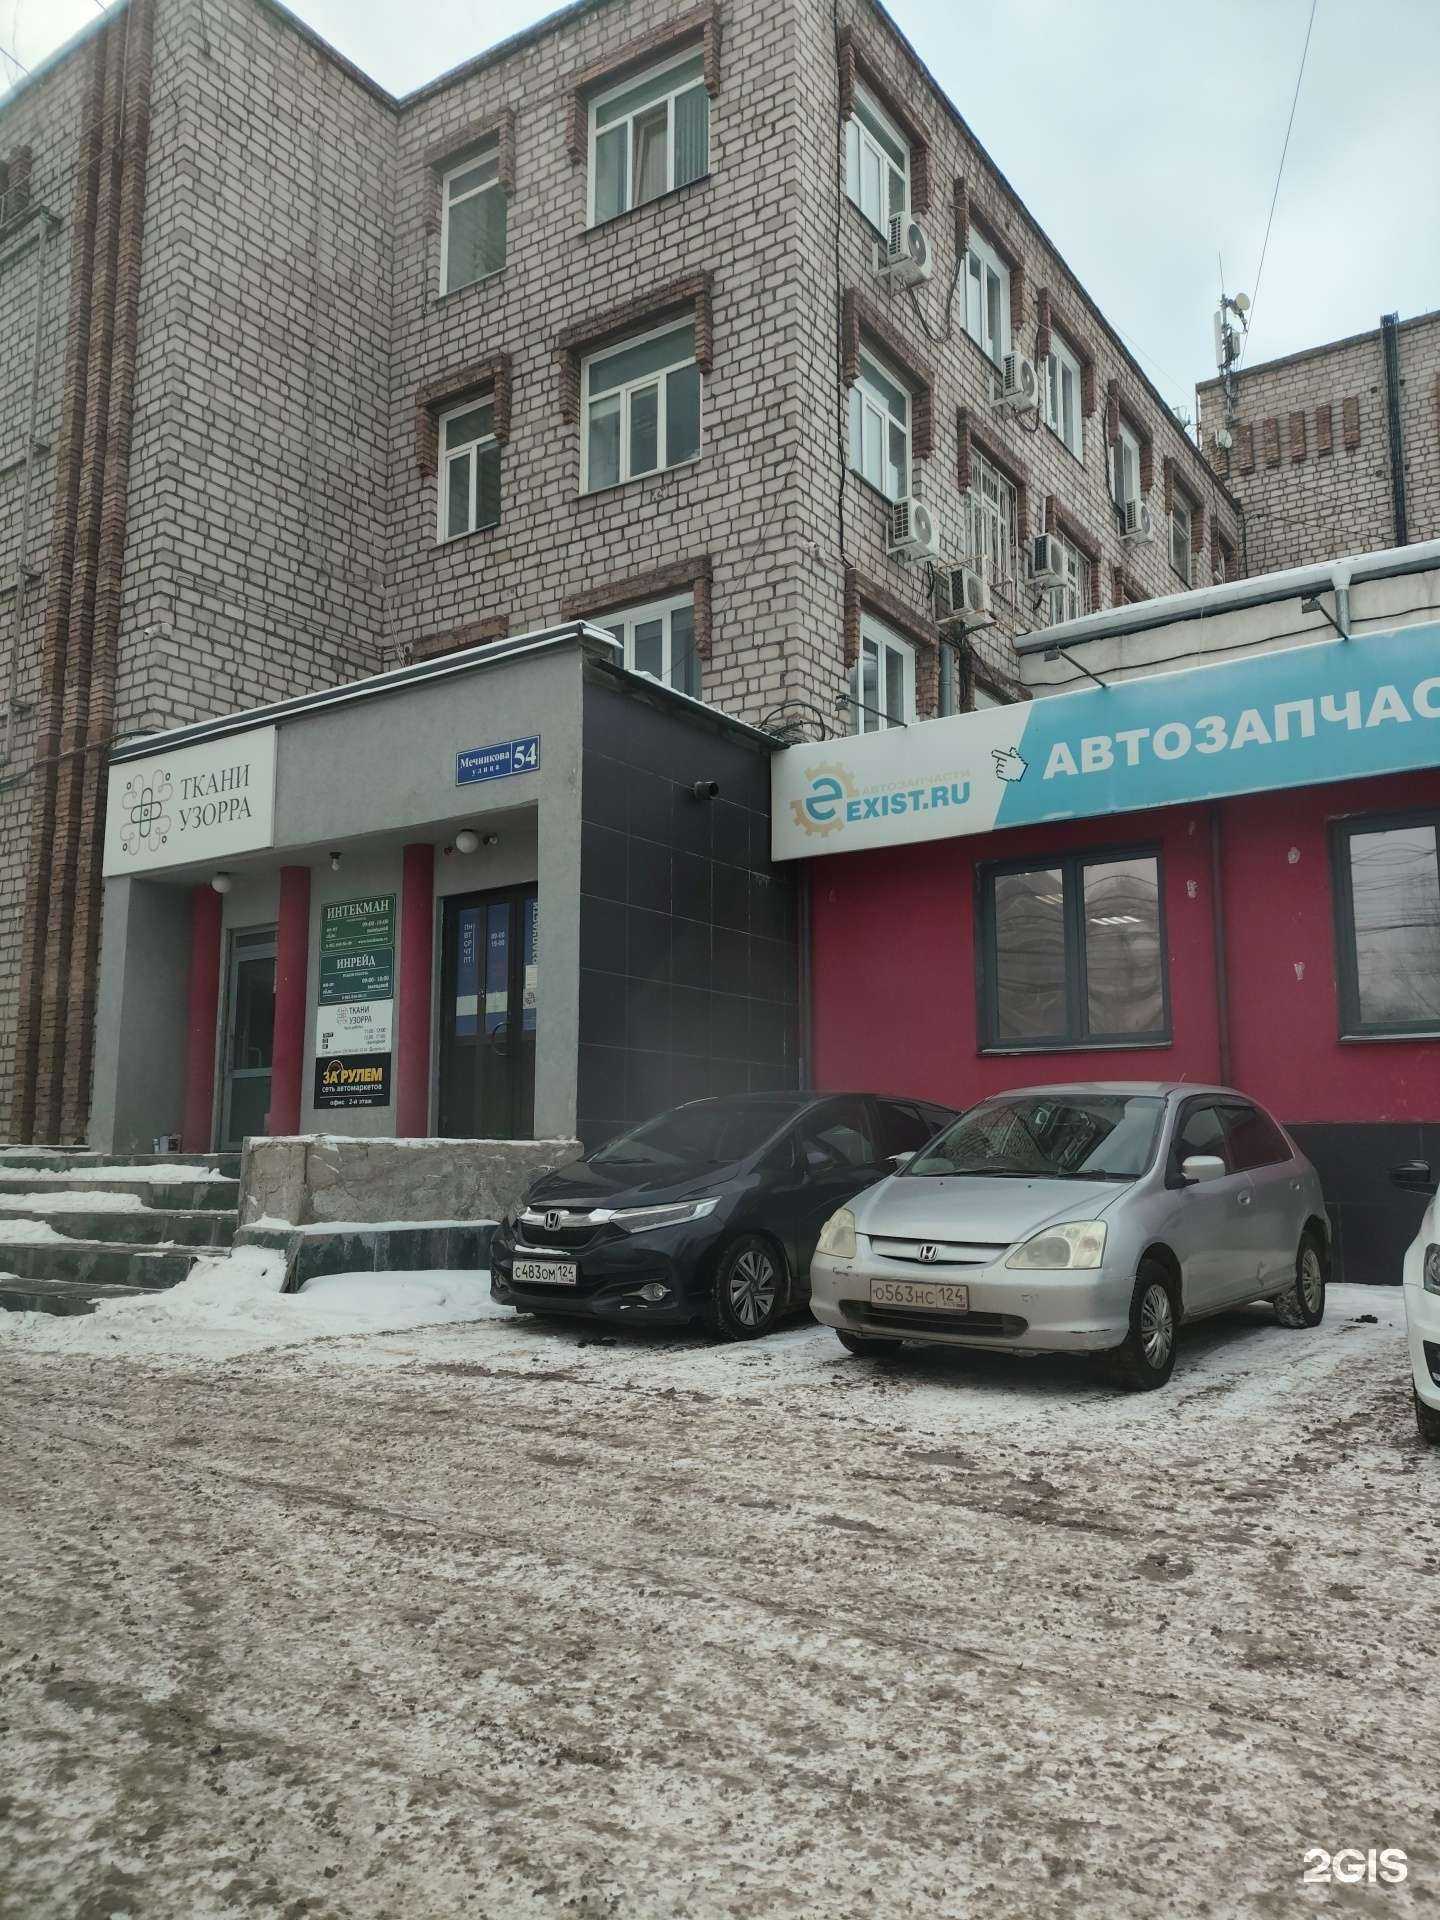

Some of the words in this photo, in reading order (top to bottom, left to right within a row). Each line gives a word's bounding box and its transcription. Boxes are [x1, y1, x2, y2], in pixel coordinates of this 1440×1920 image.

[1042, 676, 1440, 780] АВТОЗАПЧАС
[460, 751, 510, 769] Мечникова
[514, 742, 537, 768] 54
[471, 764, 500, 777] улица
[180, 764, 251, 800] ТКАНИ
[846, 782, 970, 822] EXIST.RU
[179, 796, 252, 832] УЗОРРА
[327, 899, 390, 919] ИНТЕКМАН
[337, 953, 376, 969] ИНРЕЙД
[349, 1006, 370, 1015] ТКАНИ
[349, 1015, 372, 1025] УЗОРРА
[322, 1070, 339, 1085] ЗА
[340, 1067, 383, 1084] РУЛЕМ
[321, 1085, 336, 1093] сеть
[336, 1083, 383, 1093] автомаркетов
[557, 1265, 574, 1278] 124
[938, 1287, 963, 1302] 124
